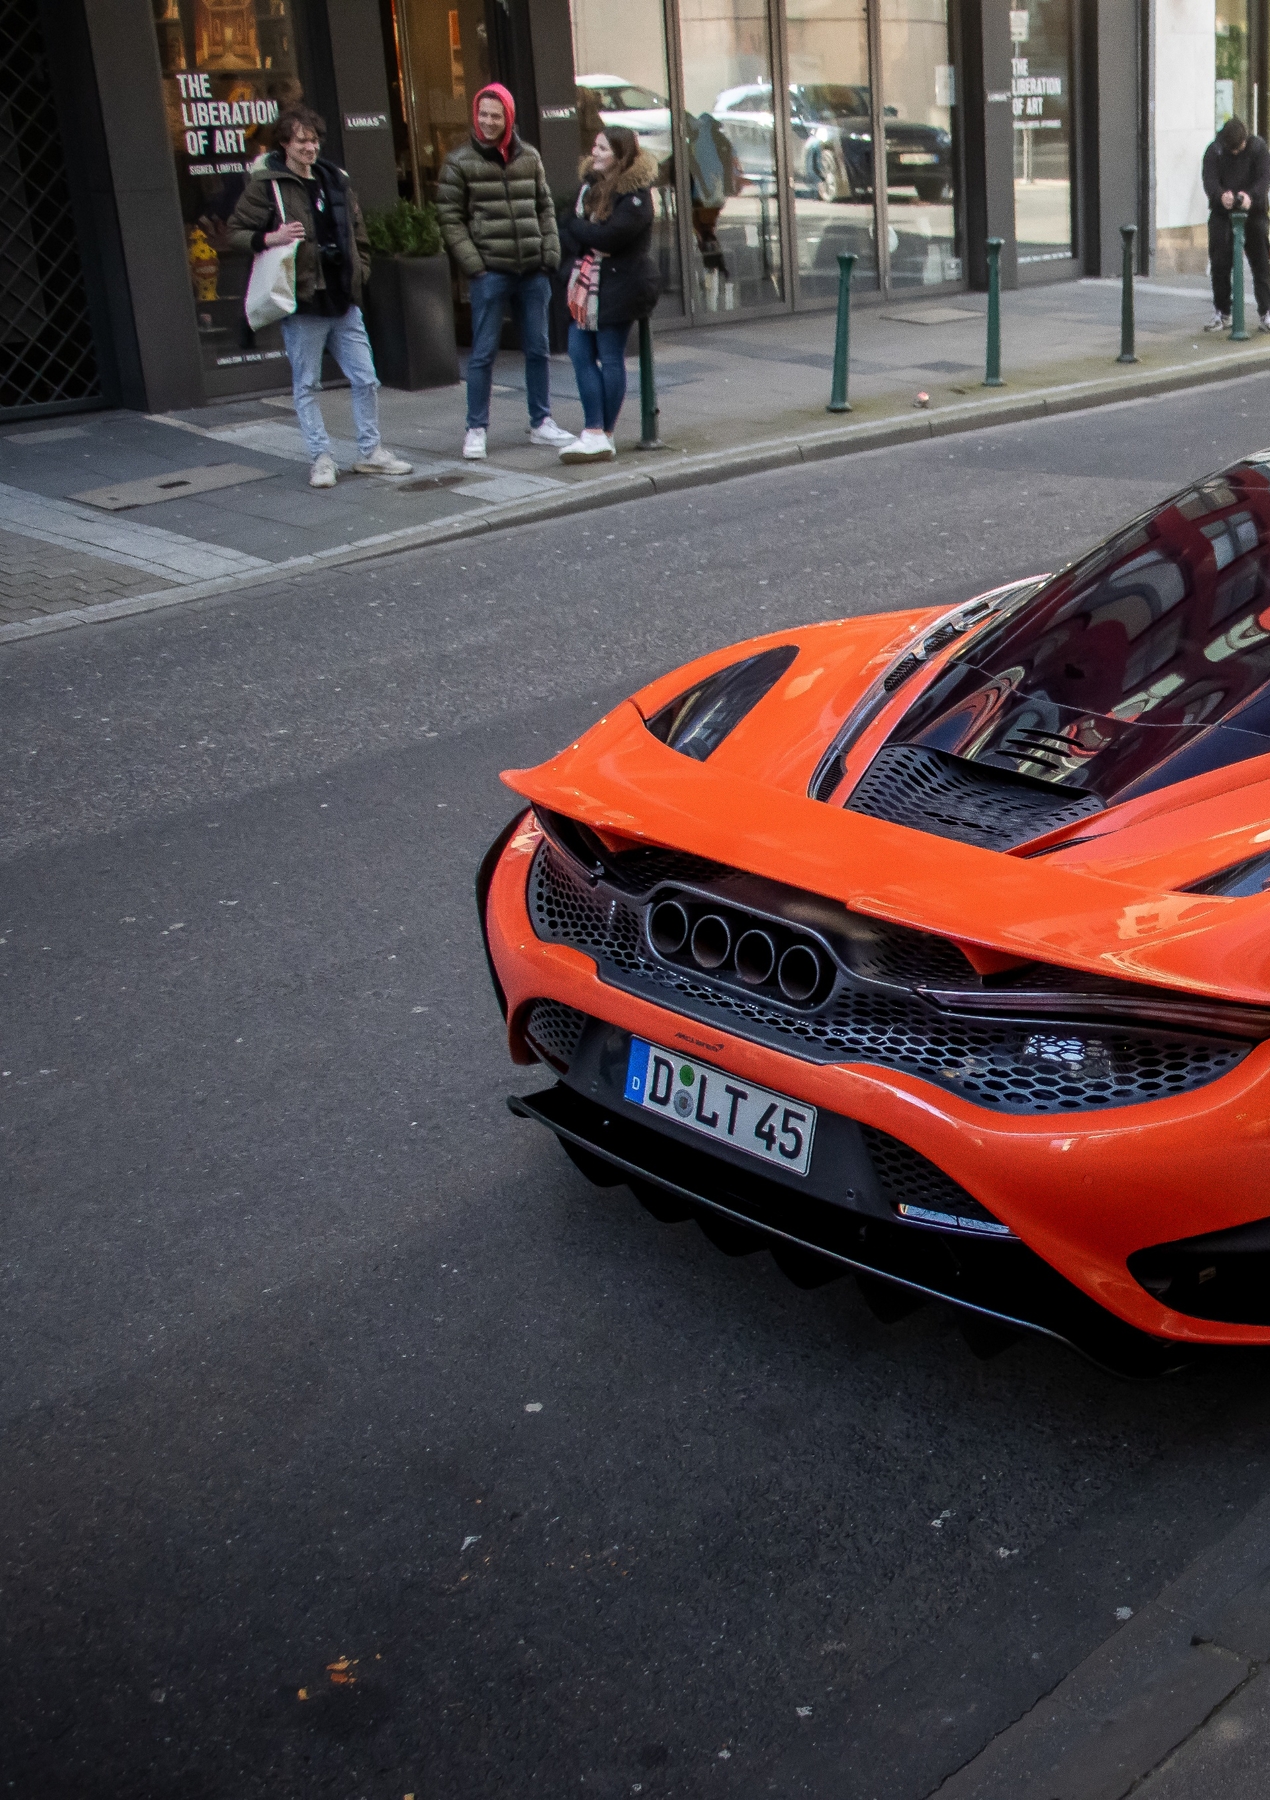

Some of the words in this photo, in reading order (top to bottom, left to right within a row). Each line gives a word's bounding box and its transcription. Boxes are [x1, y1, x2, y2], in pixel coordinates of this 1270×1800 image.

[1011, 58, 1029, 76] THE
[176, 73, 213, 99] THE
[1011, 77, 1062, 96] LIBERATION
[181, 100, 280, 127] LIBERATION
[1012, 97, 1024, 116] OF
[1026, 97, 1043, 115] ART
[347, 116, 380, 127] LUMAS
[186, 130, 209, 156] OF
[214, 129, 246, 154] ART
[631, 1076, 640, 1090] D
[649, 1055, 674, 1106] D
[695, 1074, 749, 1135] LT
[754, 1102, 808, 1159] 45
